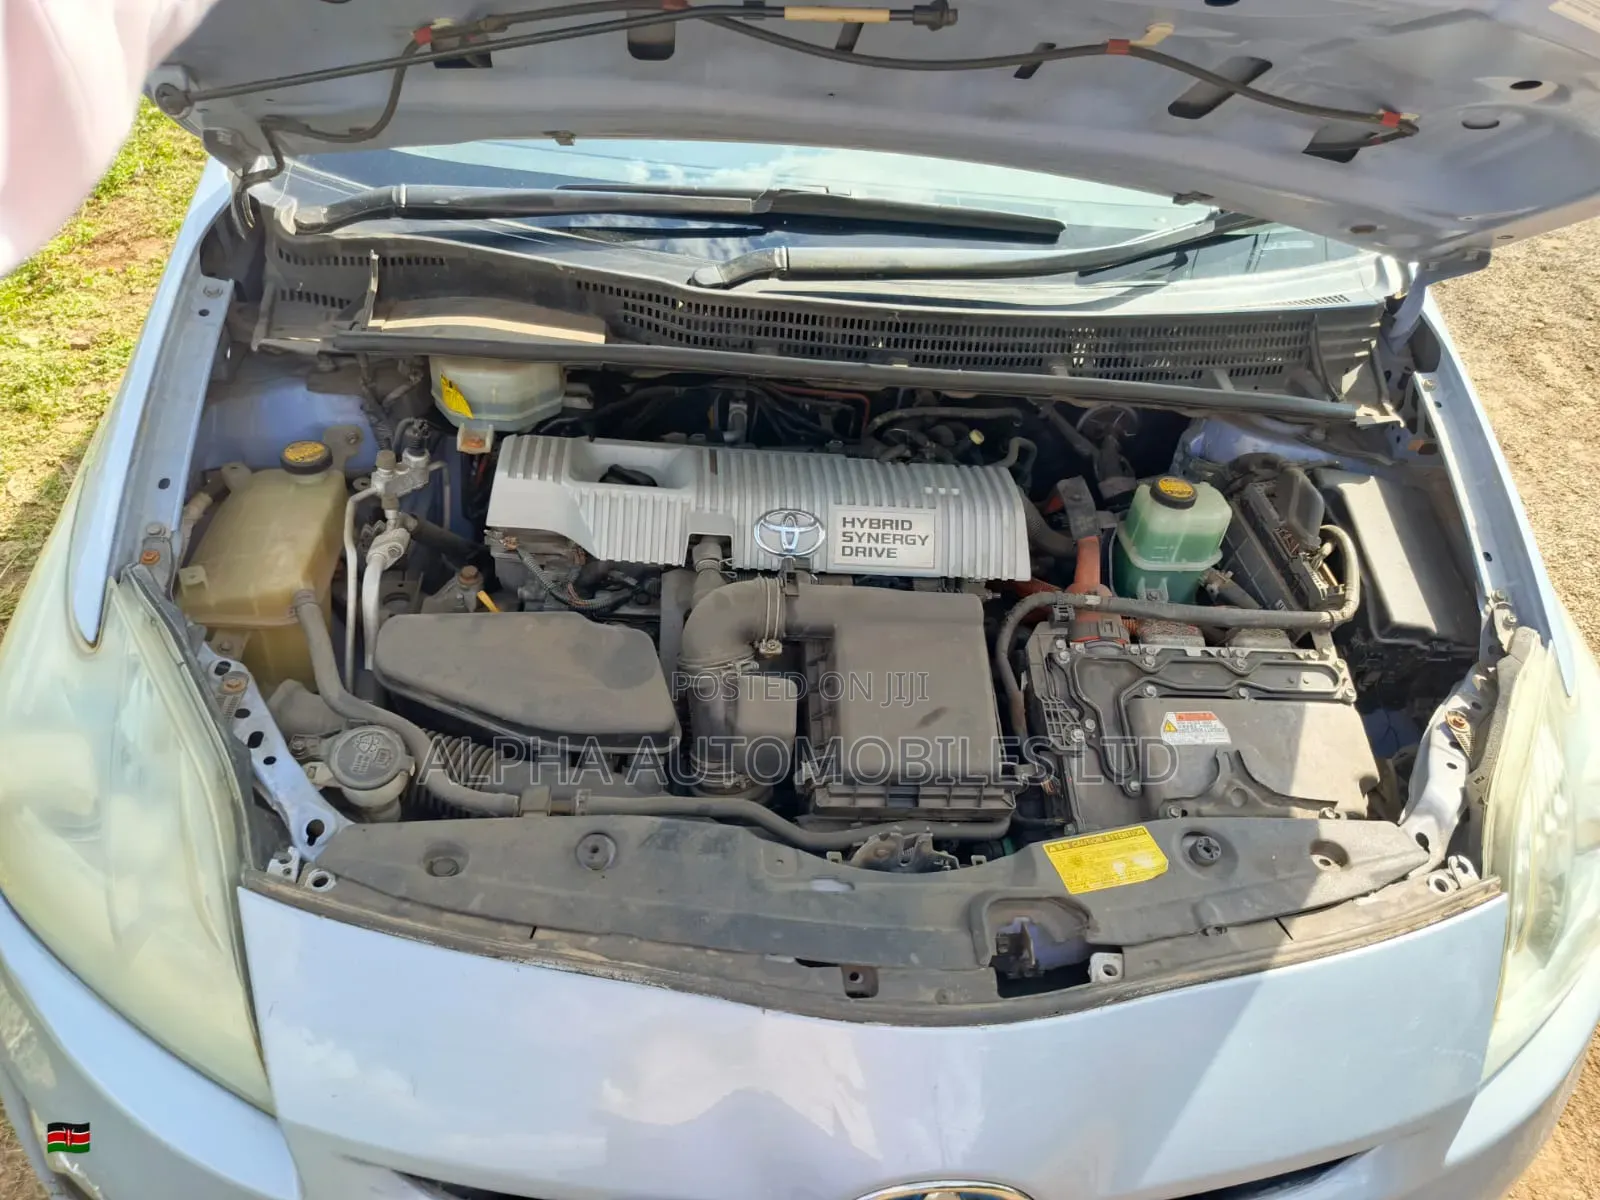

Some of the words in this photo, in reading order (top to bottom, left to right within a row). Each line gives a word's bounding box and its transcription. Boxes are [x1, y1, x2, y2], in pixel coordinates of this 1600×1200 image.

[842, 517, 912, 531] HYBRID
[841, 532, 928, 546] SYNERGY
[841, 546, 897, 558] DRIVE
